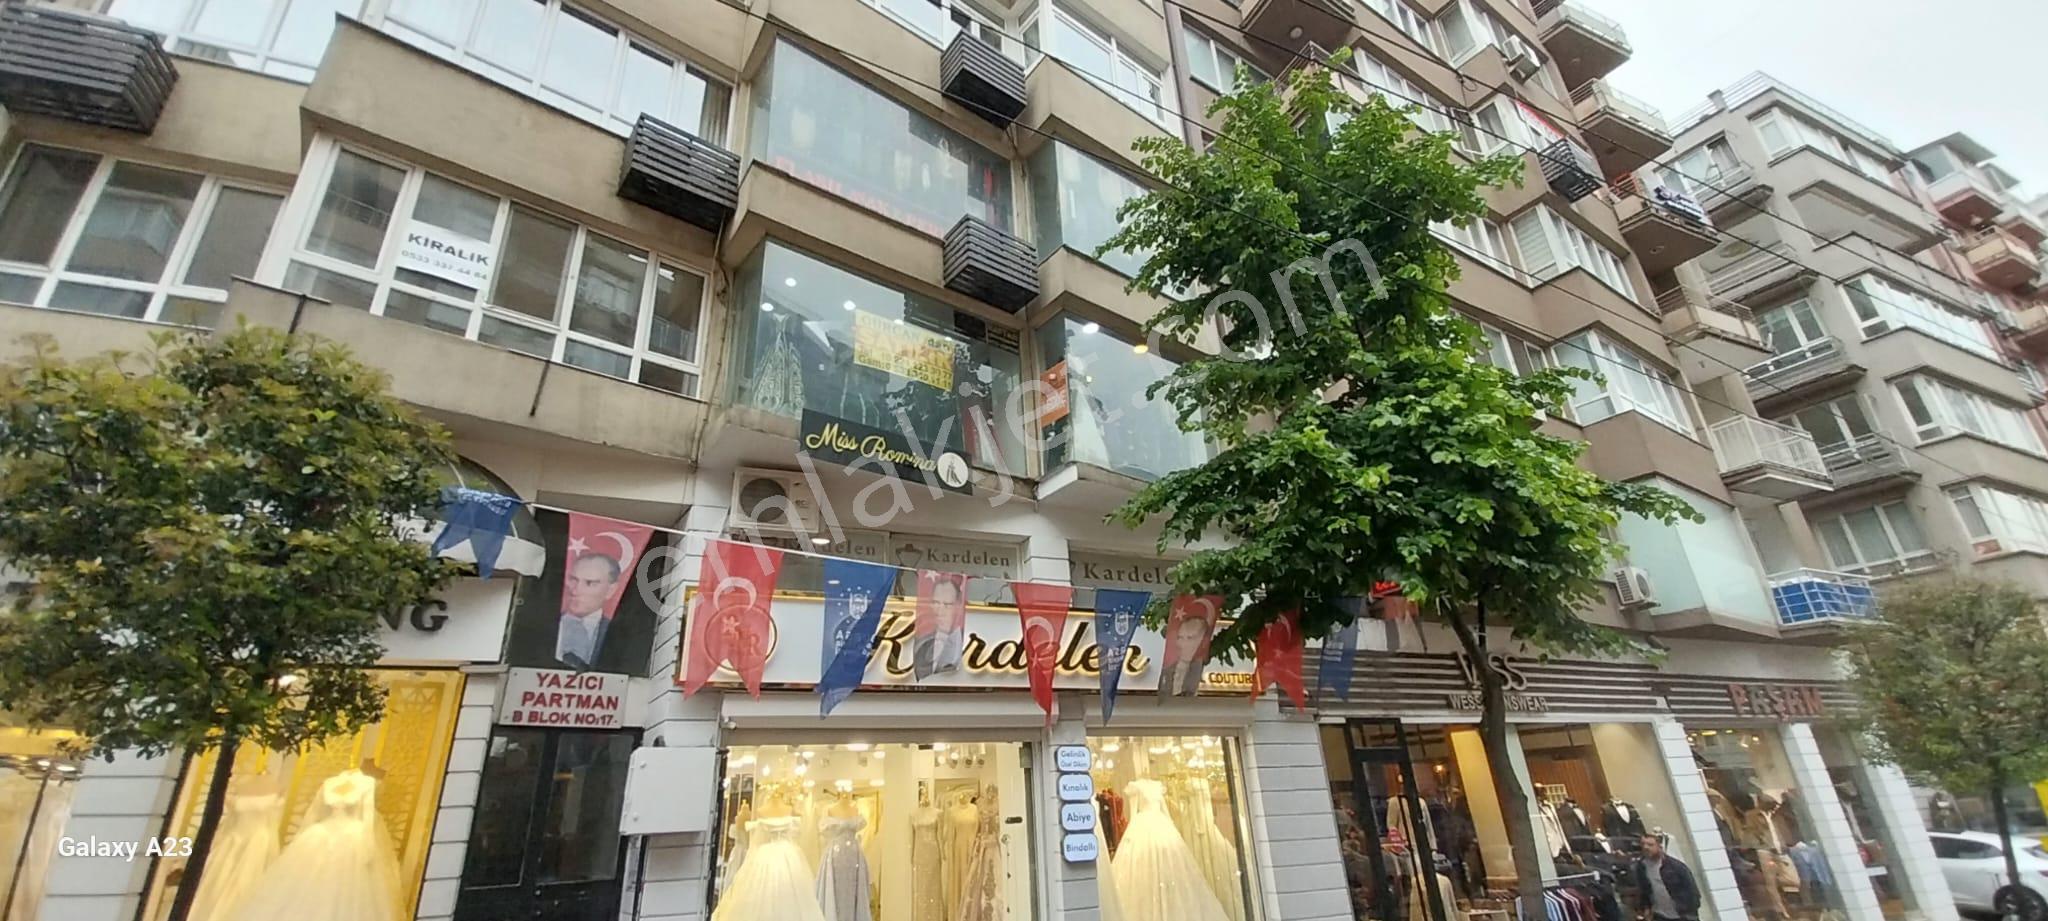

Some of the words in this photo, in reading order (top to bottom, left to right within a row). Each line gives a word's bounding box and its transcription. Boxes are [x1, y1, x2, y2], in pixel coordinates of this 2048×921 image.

[408, 233, 489, 266] KIRALIK
[805, 422, 858, 452] Miss
[860, 435, 937, 472] Romina
[927, 548, 1010, 567] Kardelen
[537, 672, 604, 691] YAZICI
[521, 691, 619, 710] PARTMAN
[512, 710, 523, 723] B
[527, 710, 571, 724] BLOK
[1066, 811, 1092, 824] Abiye
